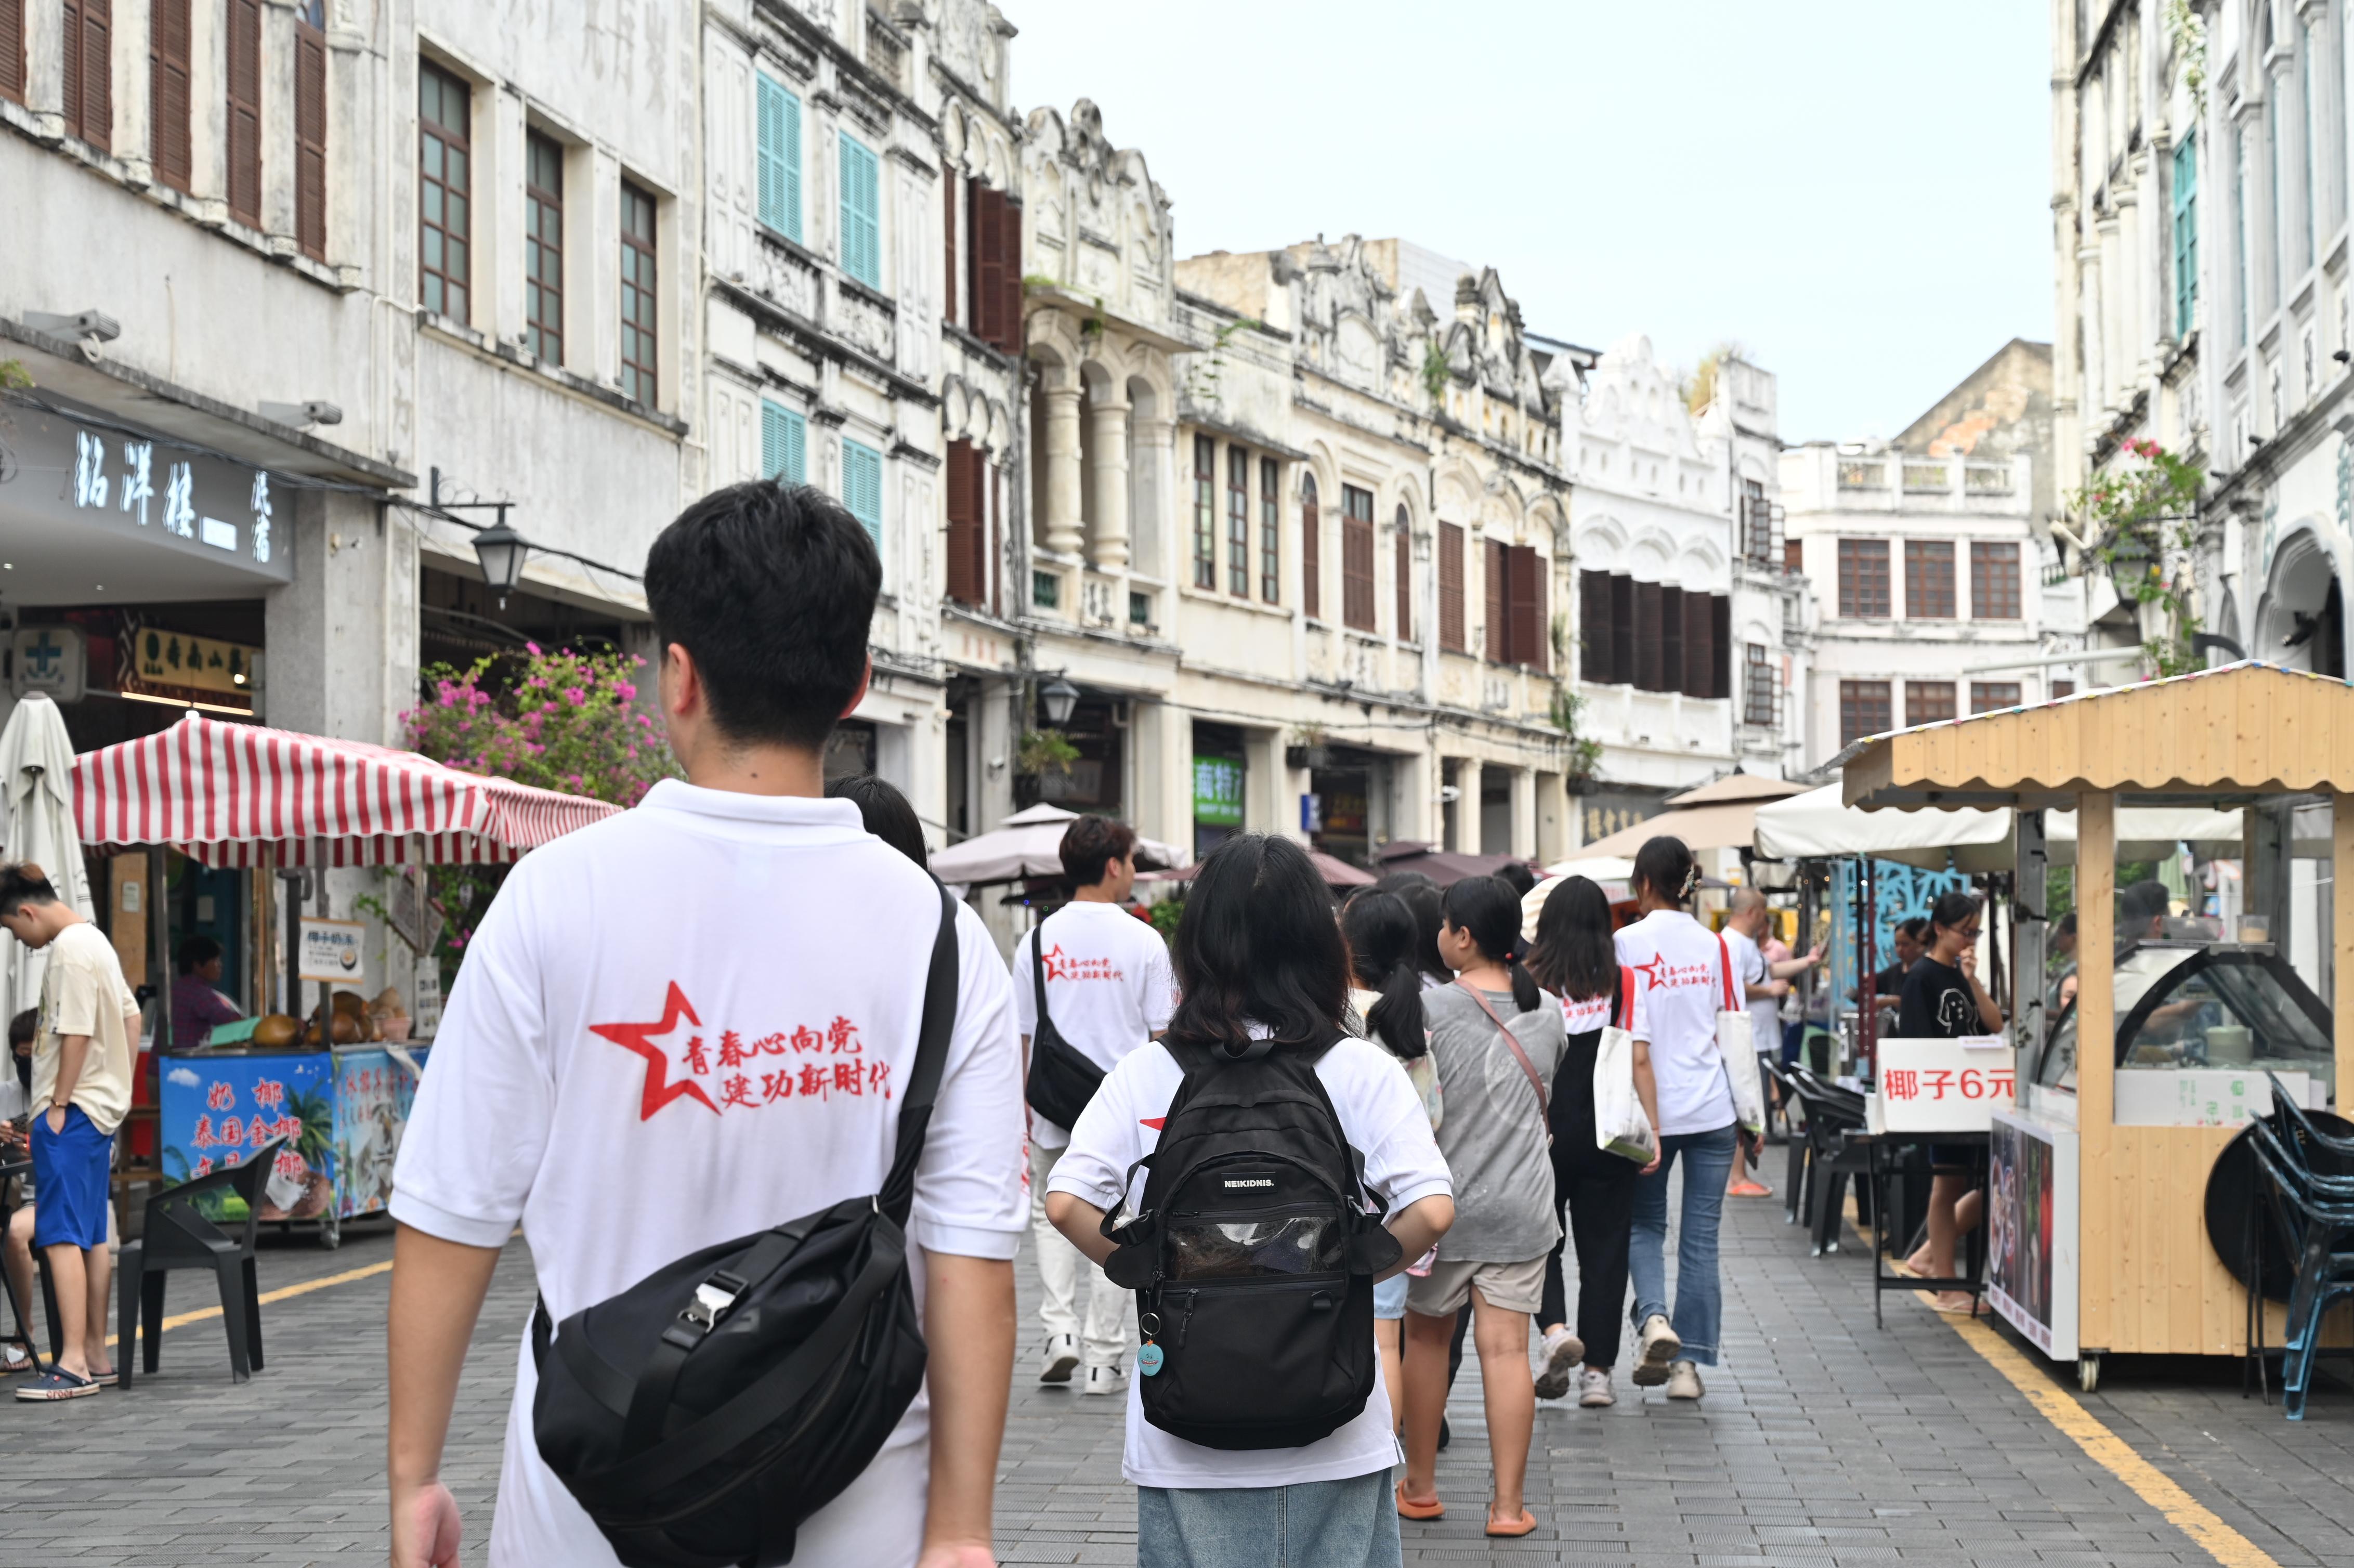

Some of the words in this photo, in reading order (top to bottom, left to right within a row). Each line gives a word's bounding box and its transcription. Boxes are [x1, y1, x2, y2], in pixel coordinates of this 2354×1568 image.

[682, 1015, 862, 1075] 青春心向党
[720, 1057, 891, 1109] 建功新时代
[1884, 1068, 2015, 1100] 椰子6元
[190, 1113, 303, 1151] 泰国金椰
[1224, 1179, 1275, 1188] NEIKIDNIS.
